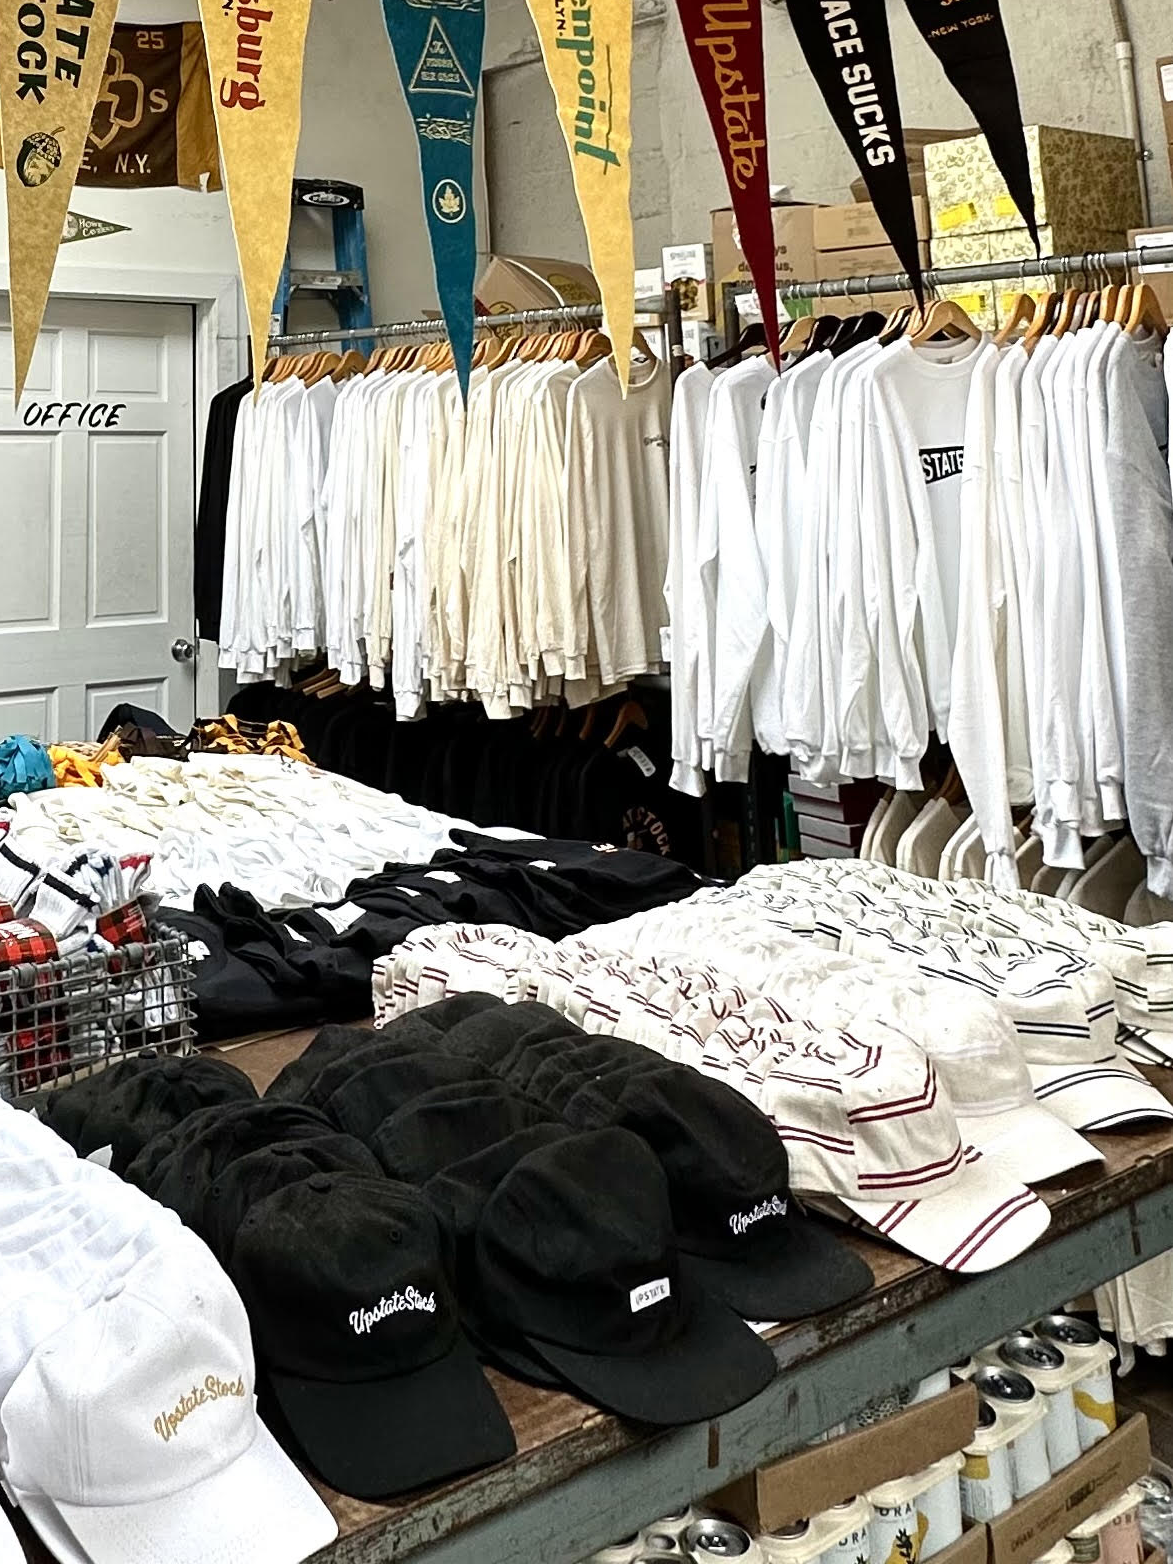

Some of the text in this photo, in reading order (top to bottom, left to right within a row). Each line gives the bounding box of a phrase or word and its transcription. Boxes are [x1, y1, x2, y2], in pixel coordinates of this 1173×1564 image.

[841, 63, 895, 167] SUCKS
[115, 153, 151, 174] N.Y.
[23, 402, 127, 428] OFFICE
